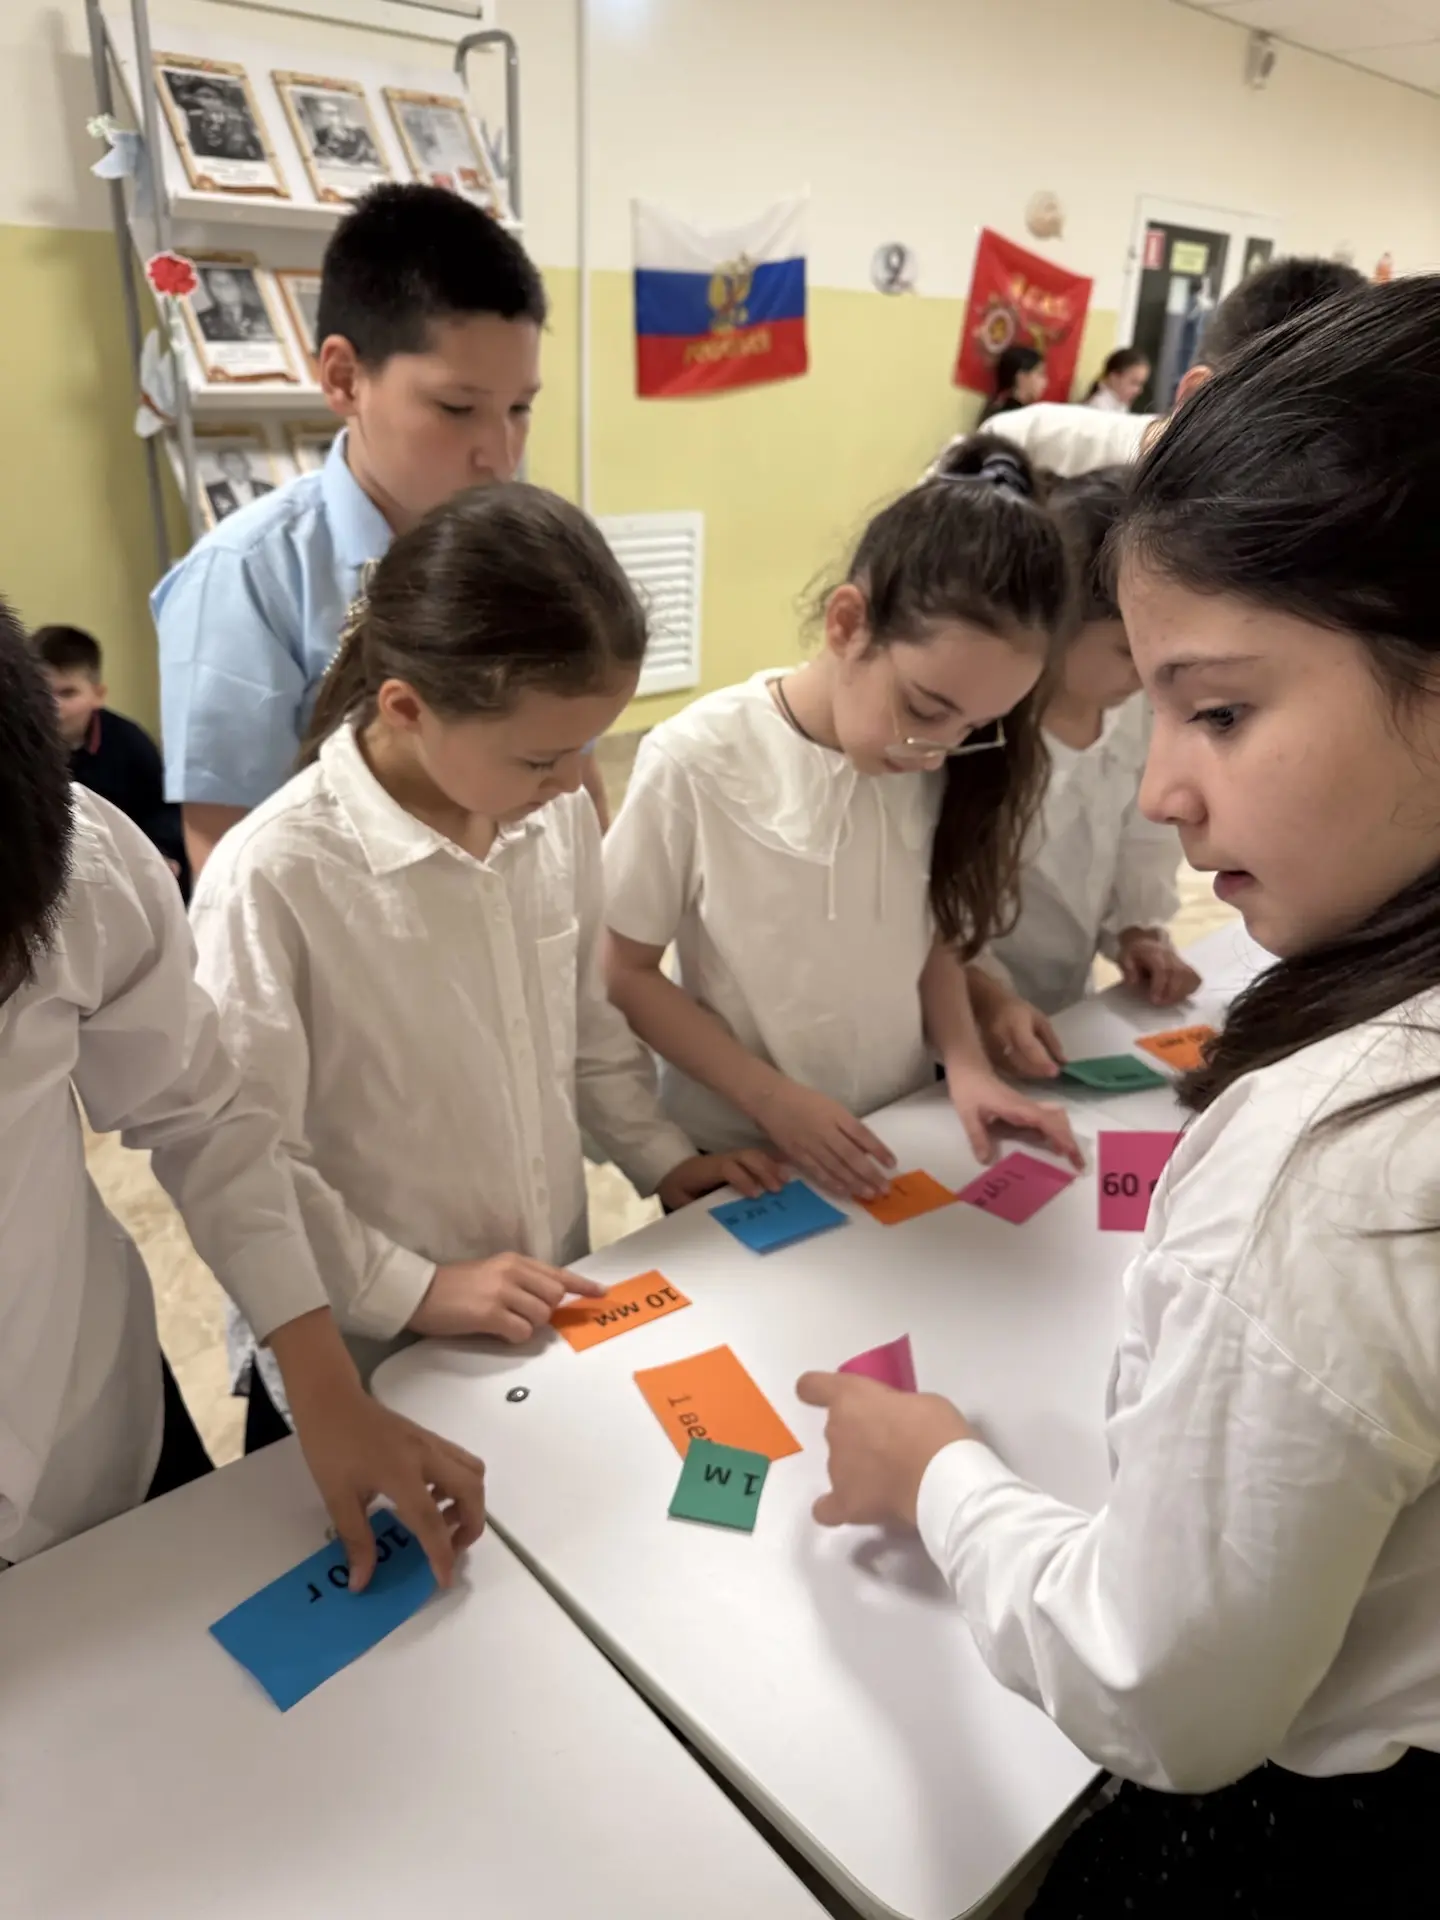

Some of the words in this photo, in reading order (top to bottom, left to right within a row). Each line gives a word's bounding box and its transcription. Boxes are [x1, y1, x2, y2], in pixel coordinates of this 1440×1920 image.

[1102, 1172, 1139, 1197] 60
[646, 1287, 677, 1308] 10
[594, 1302, 639, 1327] мм
[667, 1393, 692, 1408] 1
[678, 1412, 712, 1443] ве
[744, 1472, 760, 1496] 1
[308, 1584, 322, 1603] г
